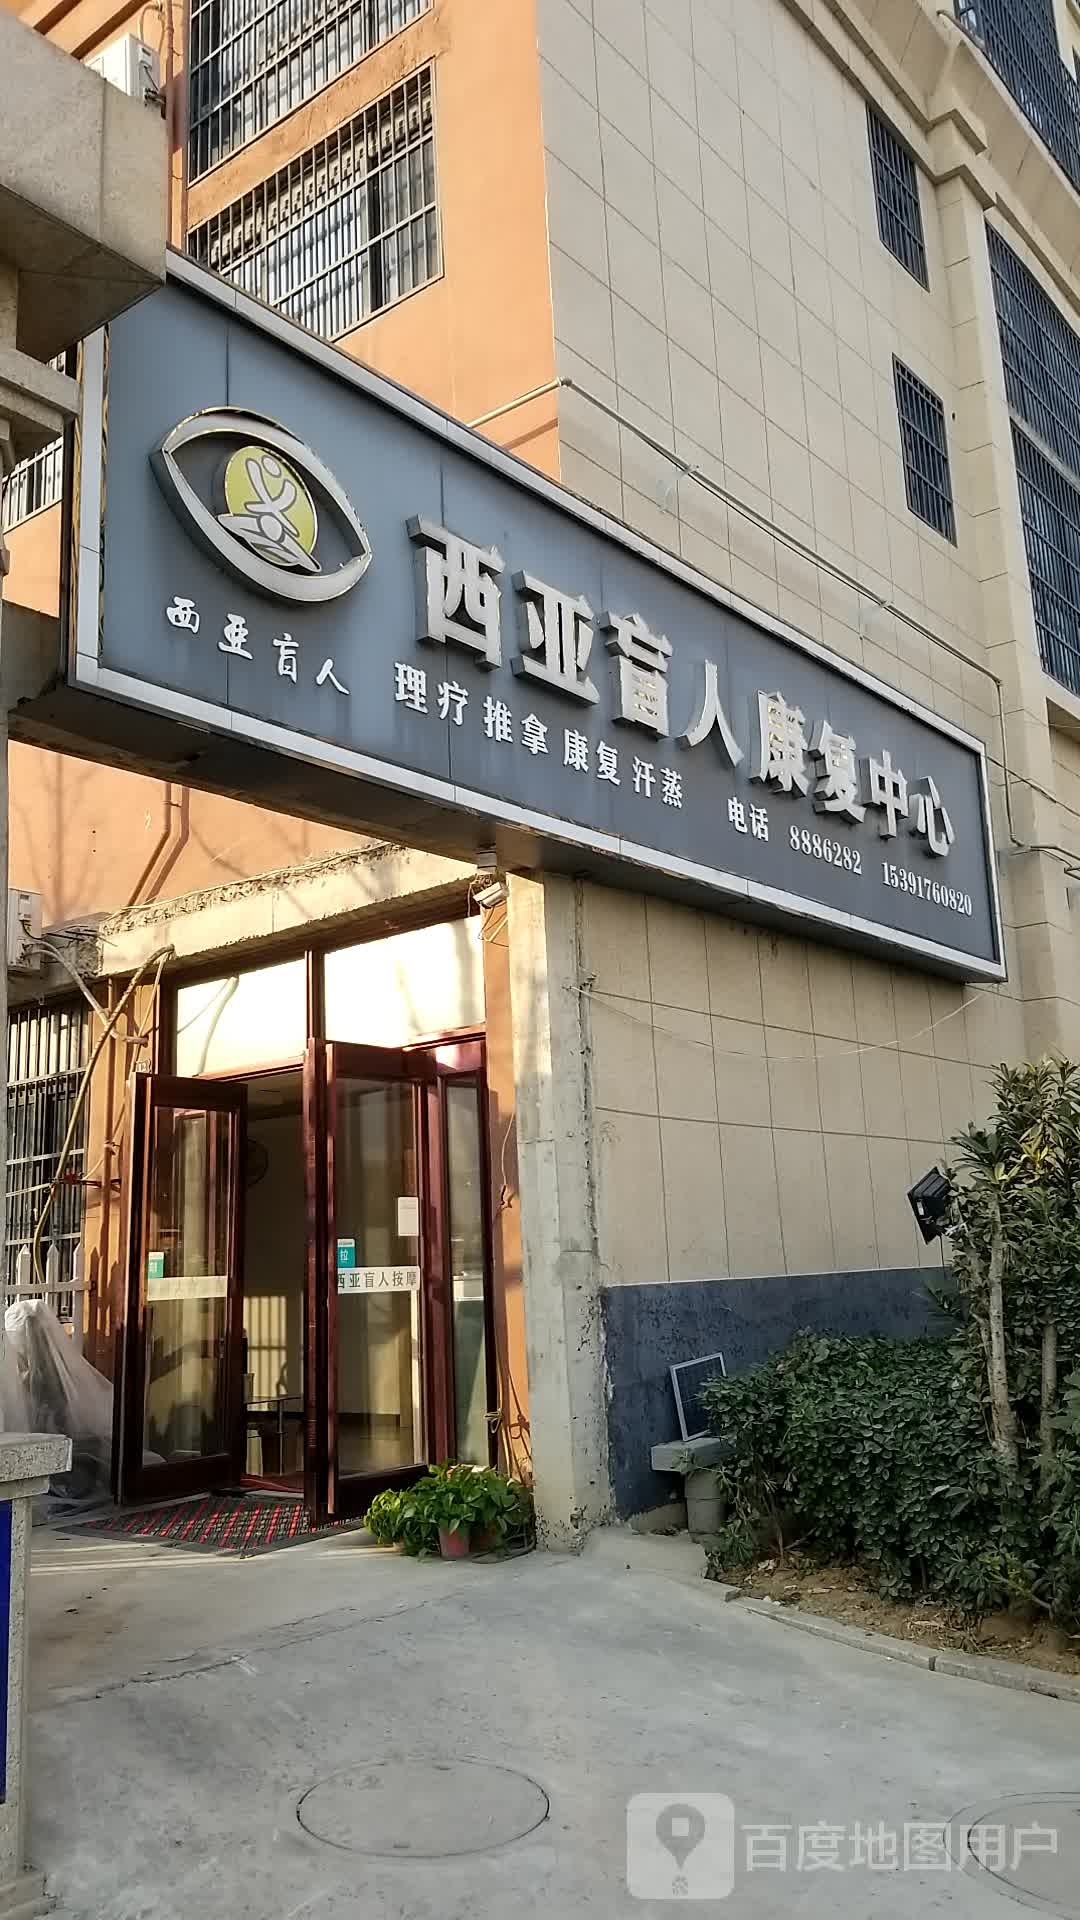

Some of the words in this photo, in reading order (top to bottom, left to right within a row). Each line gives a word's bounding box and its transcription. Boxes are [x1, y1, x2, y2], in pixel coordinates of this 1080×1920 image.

[394, 662, 683, 809] 理疗推拿康复汗蒸
[406, 514, 956, 858] 西亚盲人康复中心
[727, 796, 769, 842] 电话
[789, 825, 863, 876] 8886282
[881, 861, 973, 917] 15391760820
